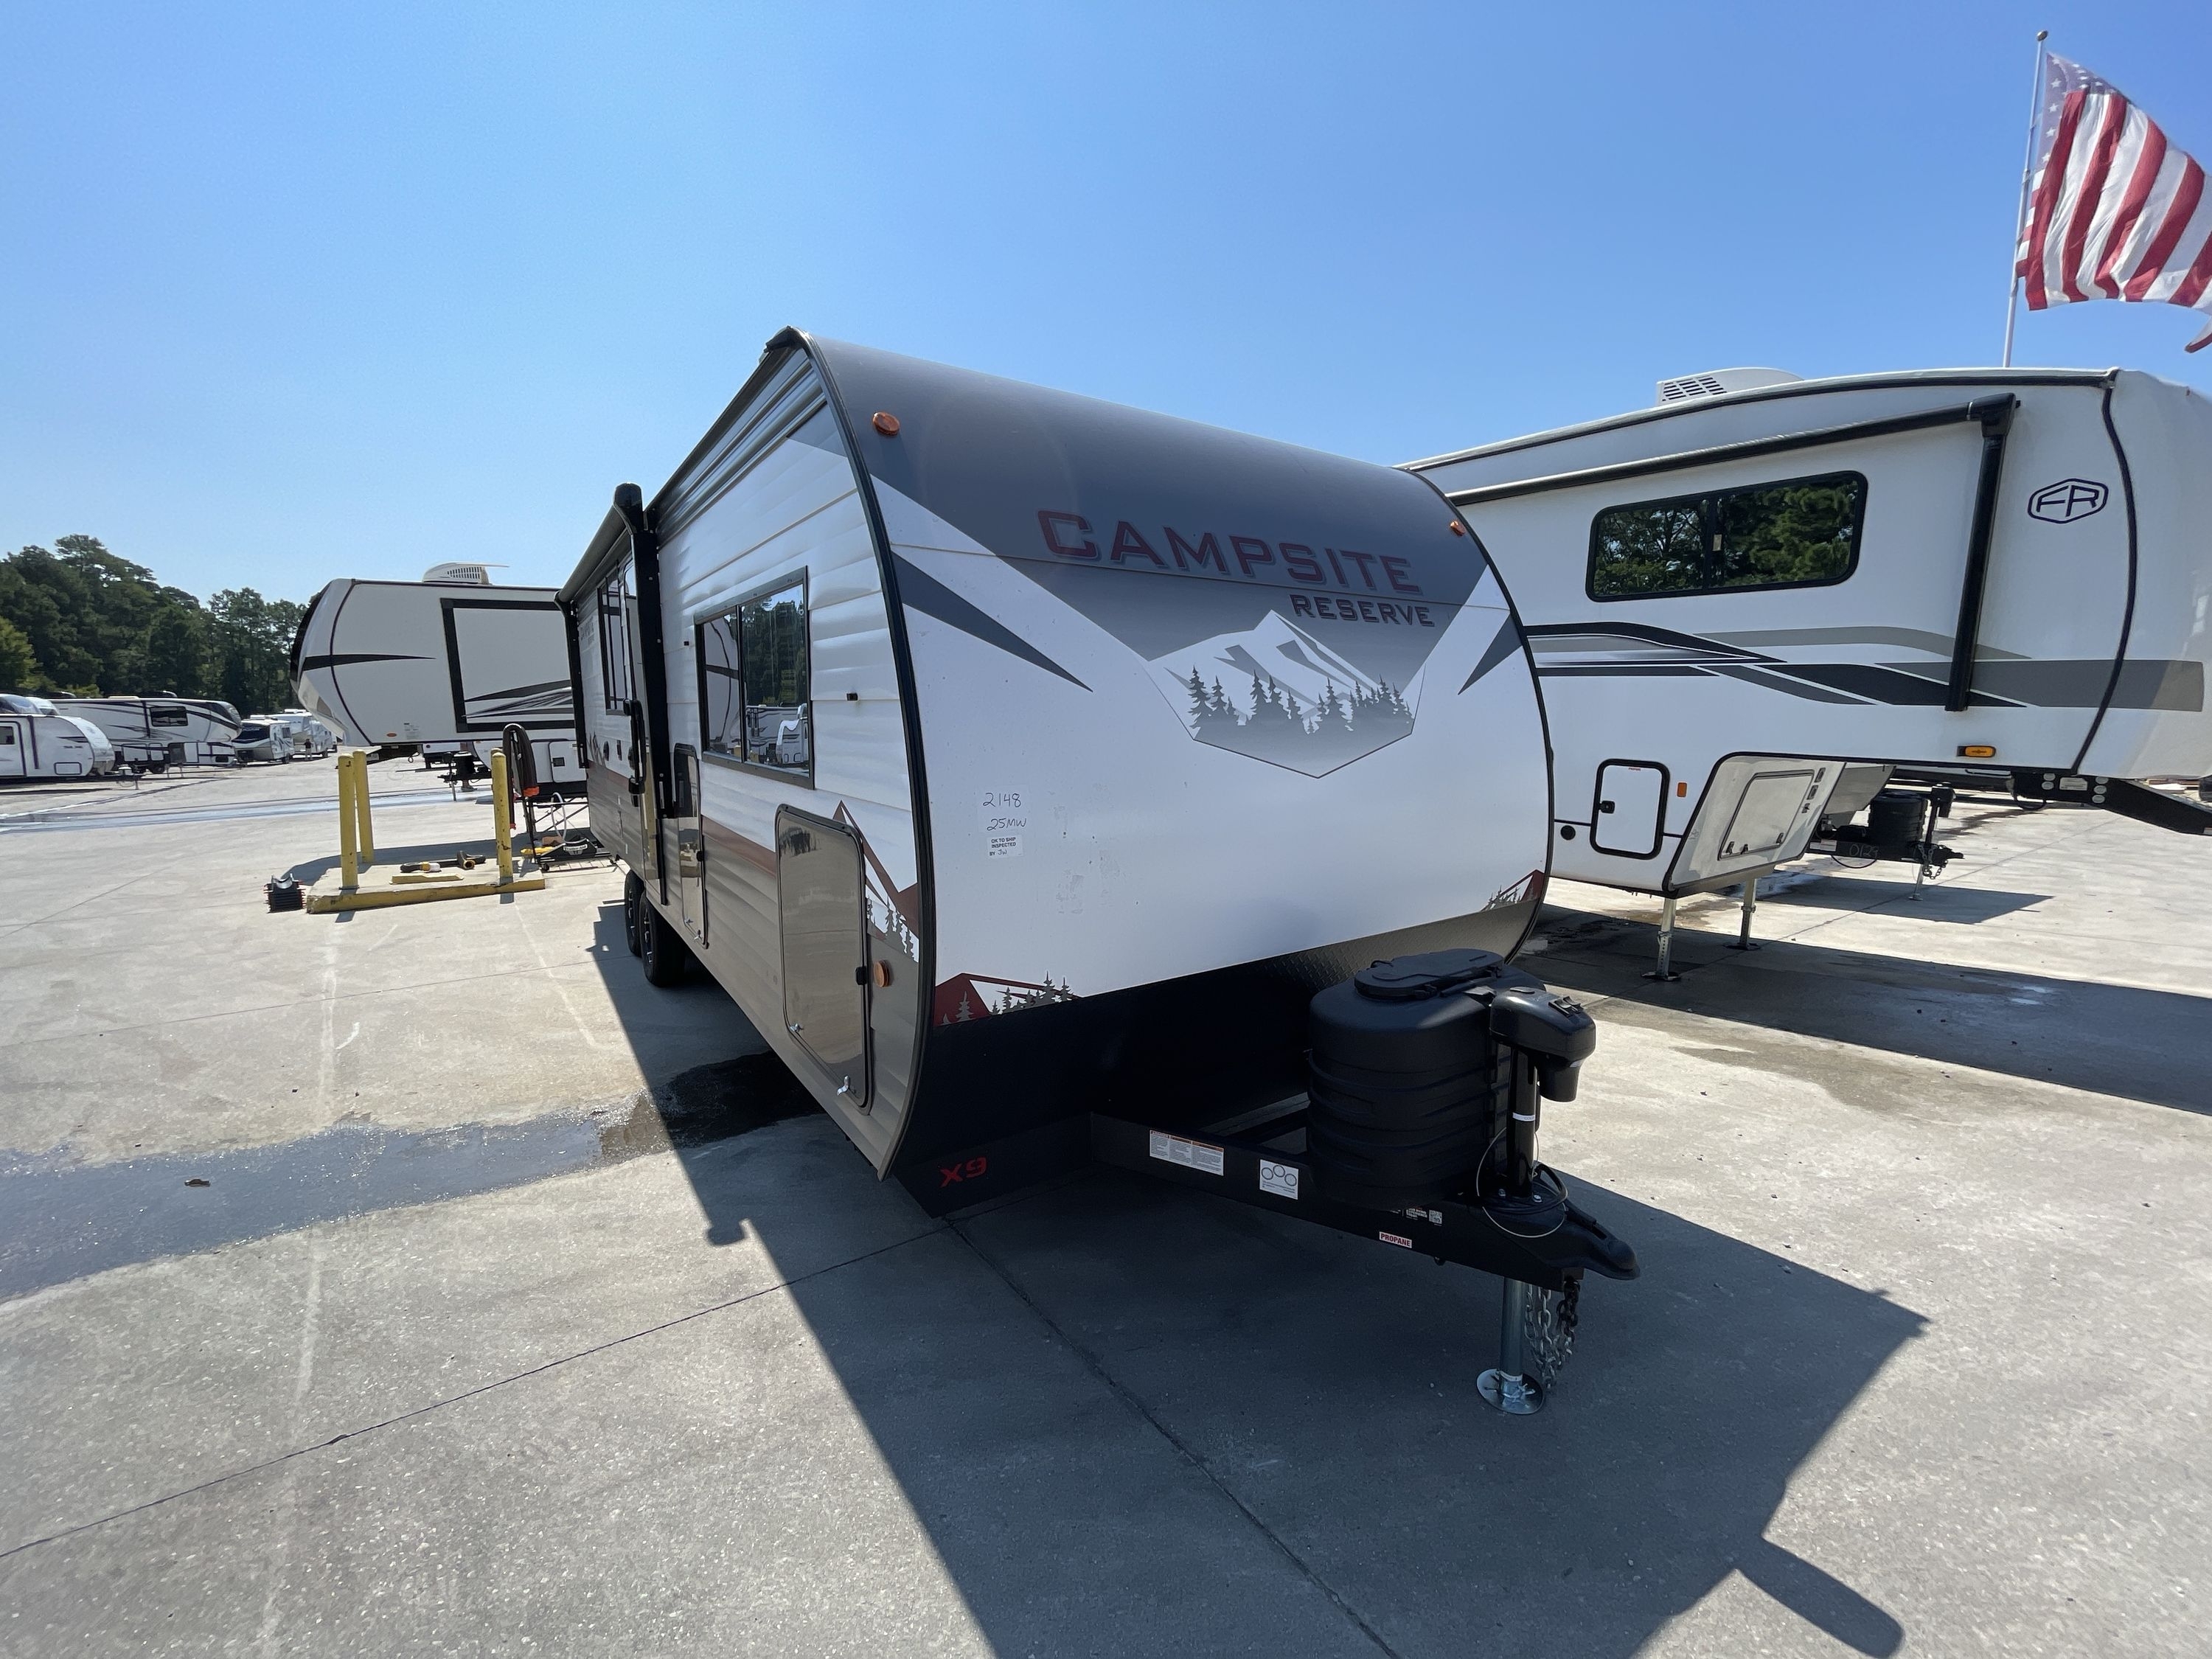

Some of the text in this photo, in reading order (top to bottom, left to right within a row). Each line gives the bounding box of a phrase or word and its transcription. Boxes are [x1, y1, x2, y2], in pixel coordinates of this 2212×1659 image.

[1037, 510, 1422, 594] CAMPSITE
[1290, 594, 1435, 627] RESERVE
[983, 793, 1021, 807] 2148
[987, 818, 1026, 831] 25MW
[939, 1157, 987, 1188] X9
[1380, 1233, 1411, 1247] PROPANE
